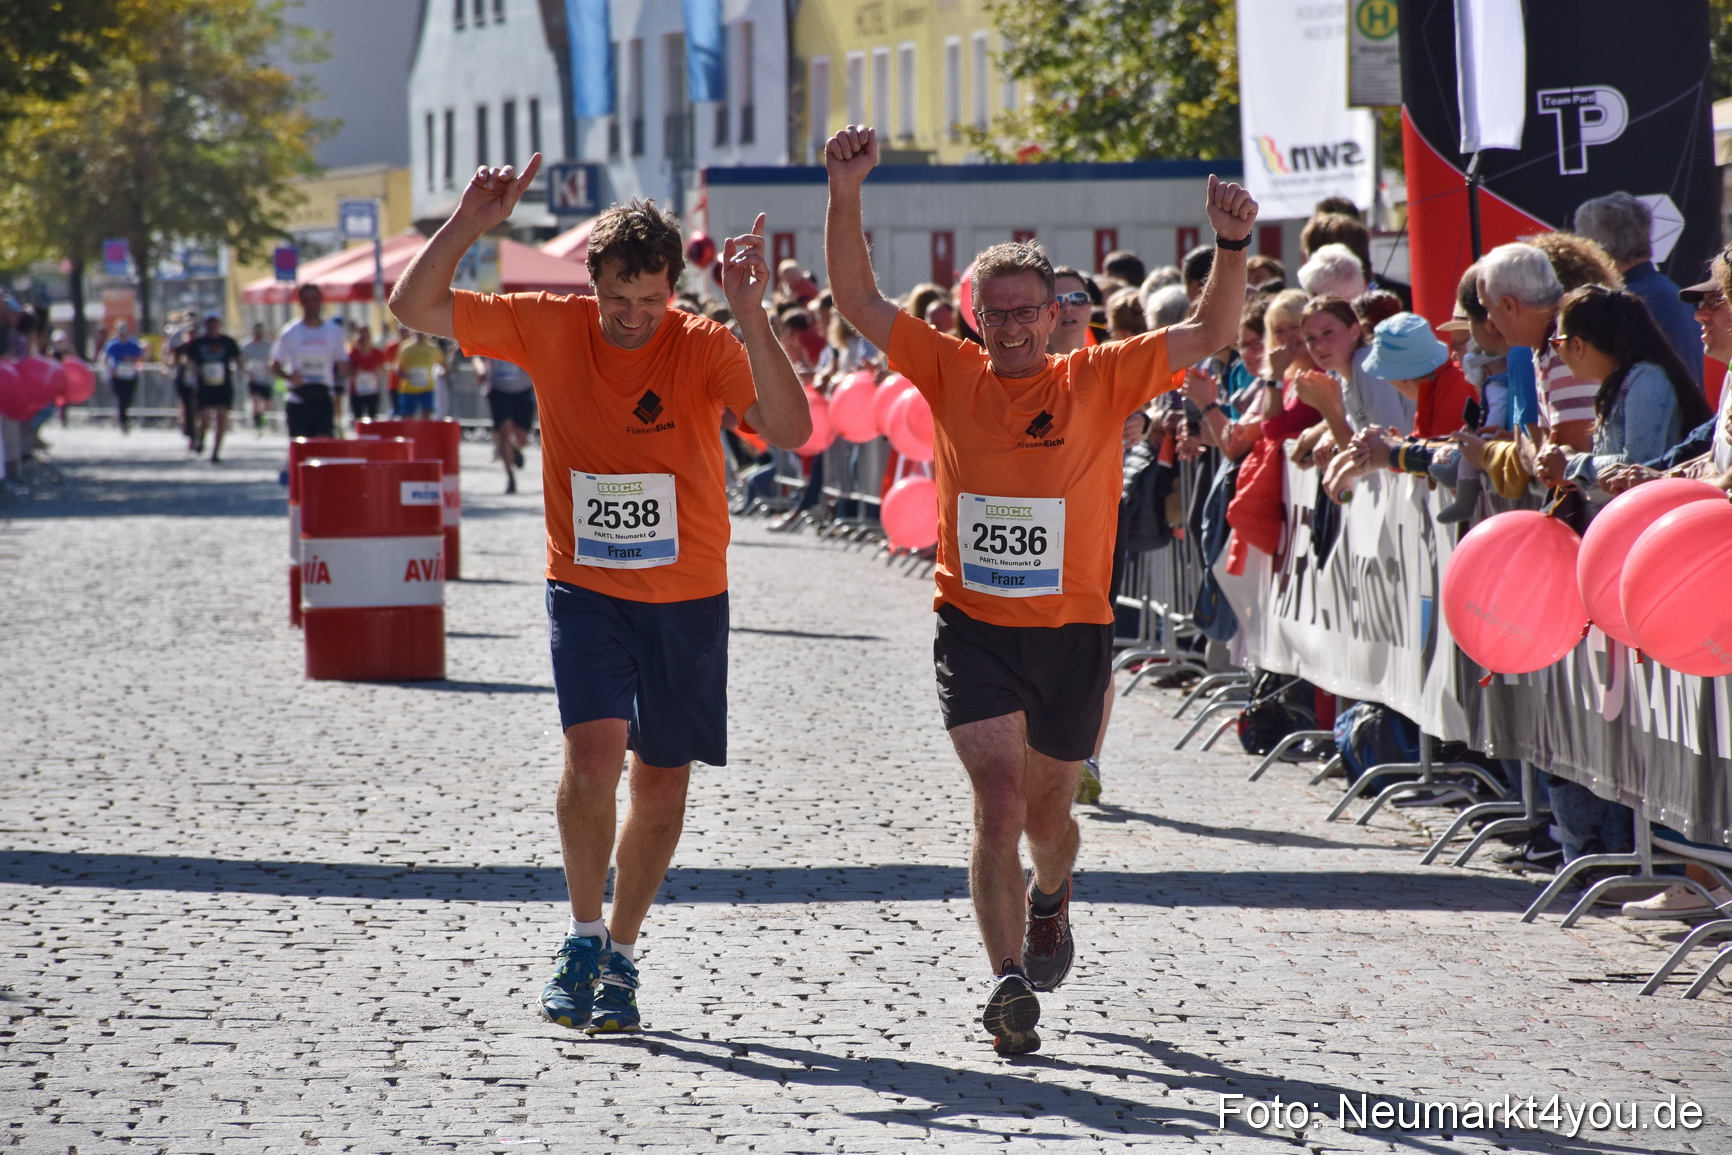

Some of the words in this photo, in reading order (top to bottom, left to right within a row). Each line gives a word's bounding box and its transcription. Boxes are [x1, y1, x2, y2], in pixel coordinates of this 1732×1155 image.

[1544, 94, 1571, 106] Team
[597, 482, 644, 493] BOCK
[587, 498, 661, 529] 2538
[985, 504, 1033, 518] BOCK
[594, 531, 614, 539] PARTL
[972, 522, 1047, 555] 2536
[608, 546, 642, 558] Franz
[980, 556, 998, 565] PARTL
[991, 572, 1026, 586] Franz
